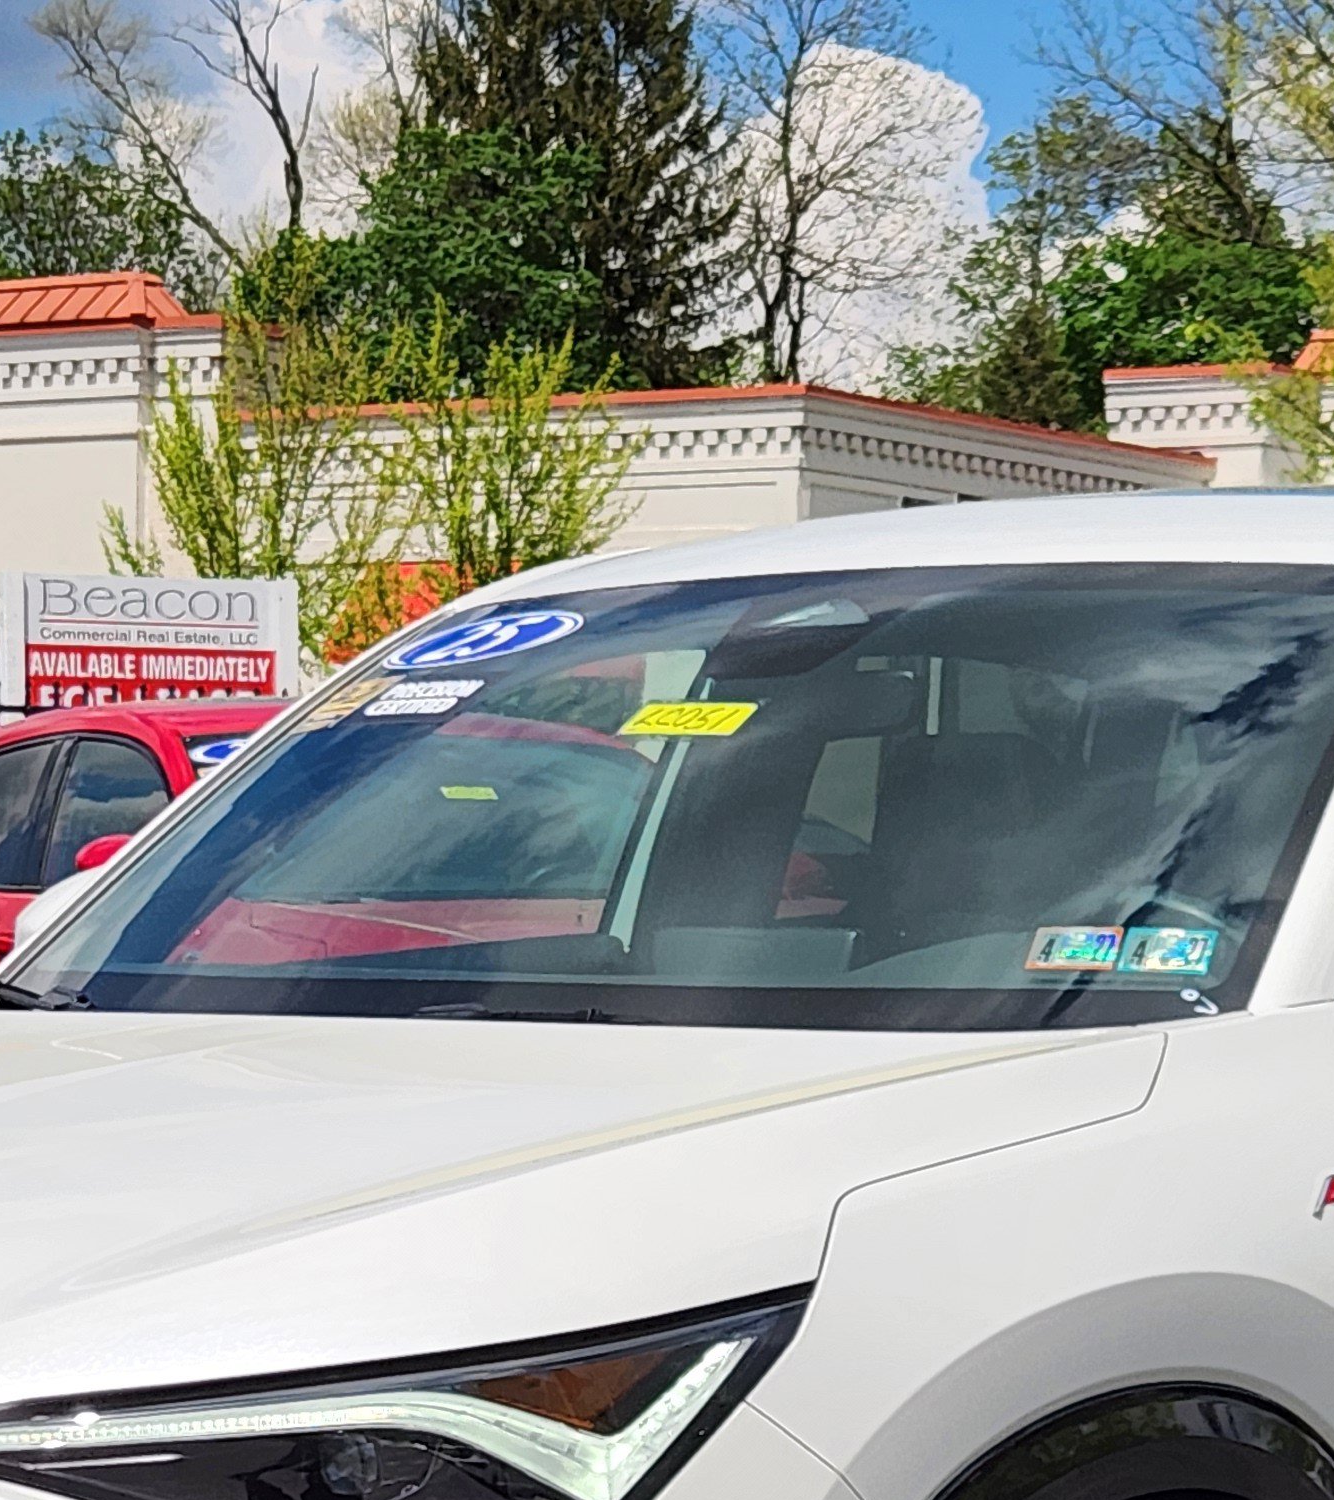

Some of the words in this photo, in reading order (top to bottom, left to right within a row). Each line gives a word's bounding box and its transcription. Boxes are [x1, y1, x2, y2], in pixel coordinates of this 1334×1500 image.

[38, 577, 260, 623] Beacon
[38, 625, 132, 643] Commercial
[135, 630, 170, 644] Real
[228, 633, 259, 646] LLC
[28, 651, 137, 680] AVAILABLE
[141, 653, 272, 684] IMMEDIATELY
